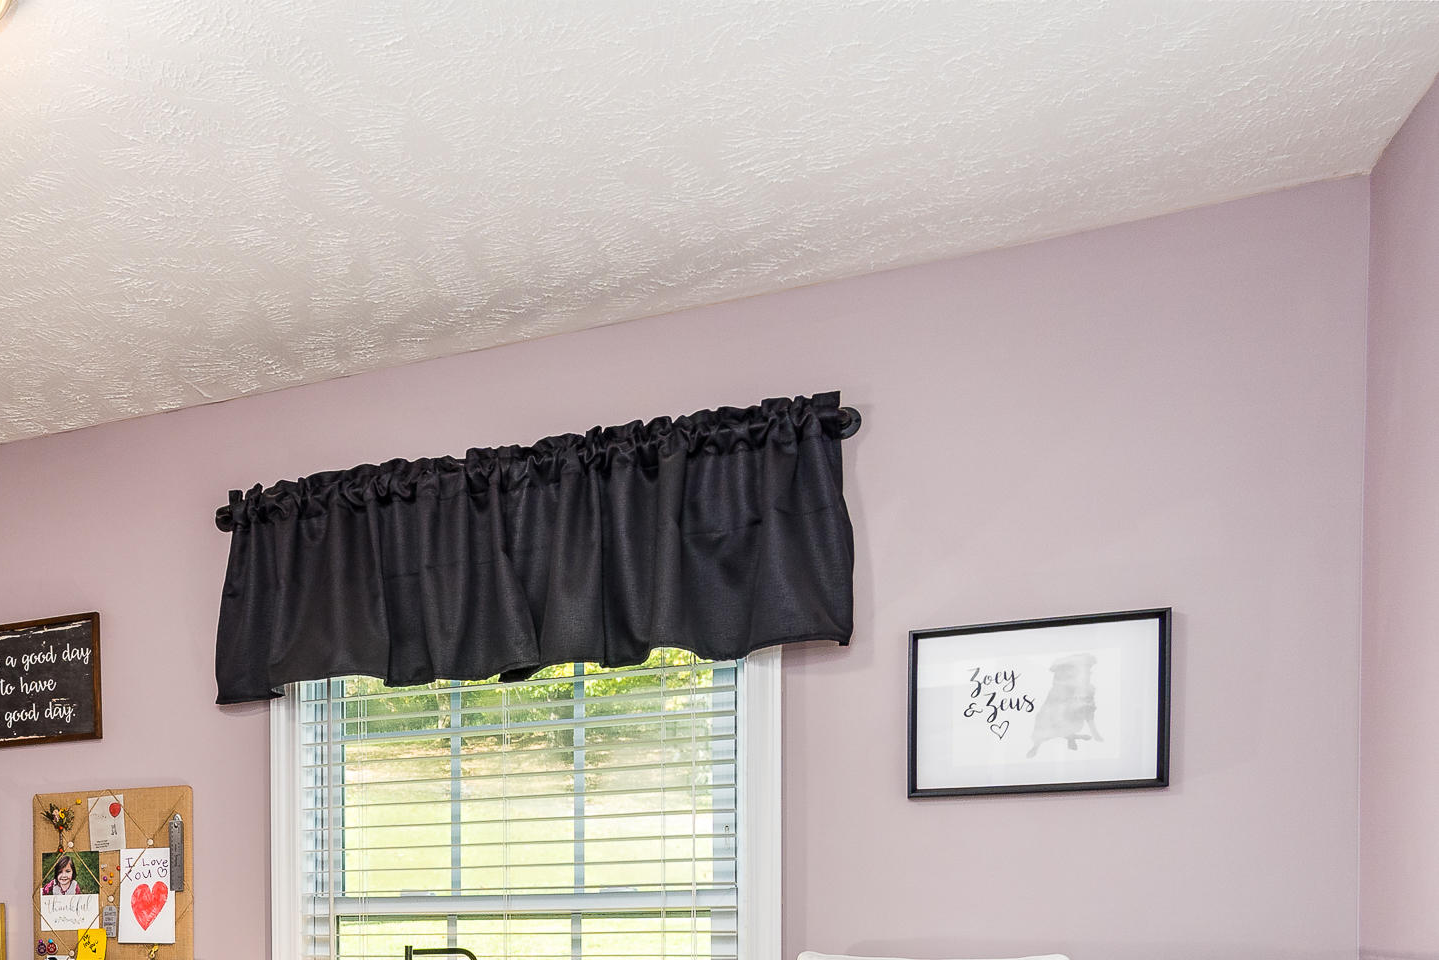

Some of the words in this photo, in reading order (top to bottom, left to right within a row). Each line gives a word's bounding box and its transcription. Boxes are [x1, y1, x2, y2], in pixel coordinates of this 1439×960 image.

[5, 656, 17, 668] a
[21, 645, 57, 671] good
[61, 643, 91, 664] day
[0, 678, 15, 695] to
[19, 676, 57, 694] have
[966, 666, 1022, 698] Zoey
[4, 703, 40, 728] good
[963, 702, 984, 717] &
[982, 692, 1035, 723] Zeus
[142, 857, 169, 868] Love
